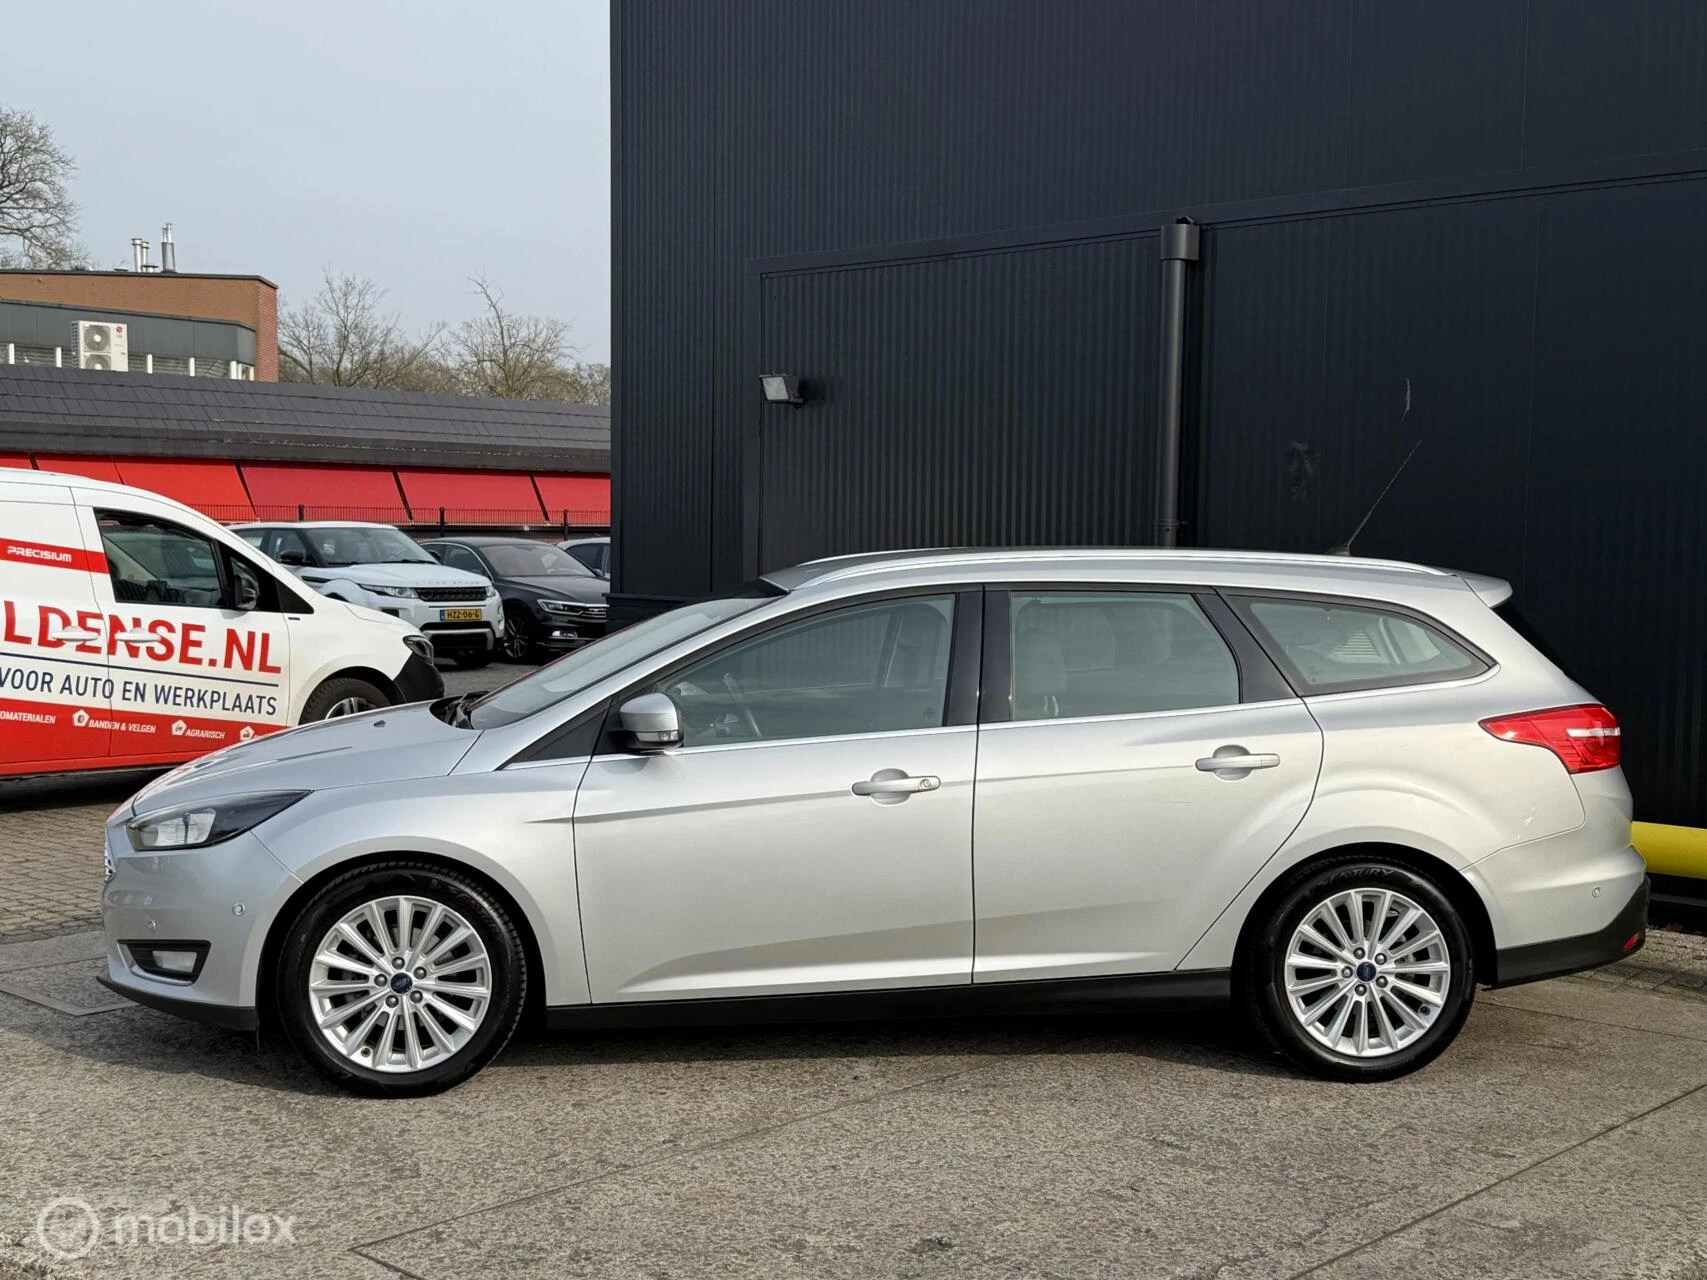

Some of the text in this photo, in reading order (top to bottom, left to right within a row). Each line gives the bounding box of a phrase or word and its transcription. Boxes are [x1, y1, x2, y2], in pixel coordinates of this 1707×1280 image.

[7, 545, 72, 563] PRECISIUM
[0, 667, 278, 716] VOOR AUTO EN WERKPLAATS
[88, 719, 120, 731] BANDEN
[128, 723, 157, 734] VELGEN
[185, 728, 226, 740] AGRARISCH
